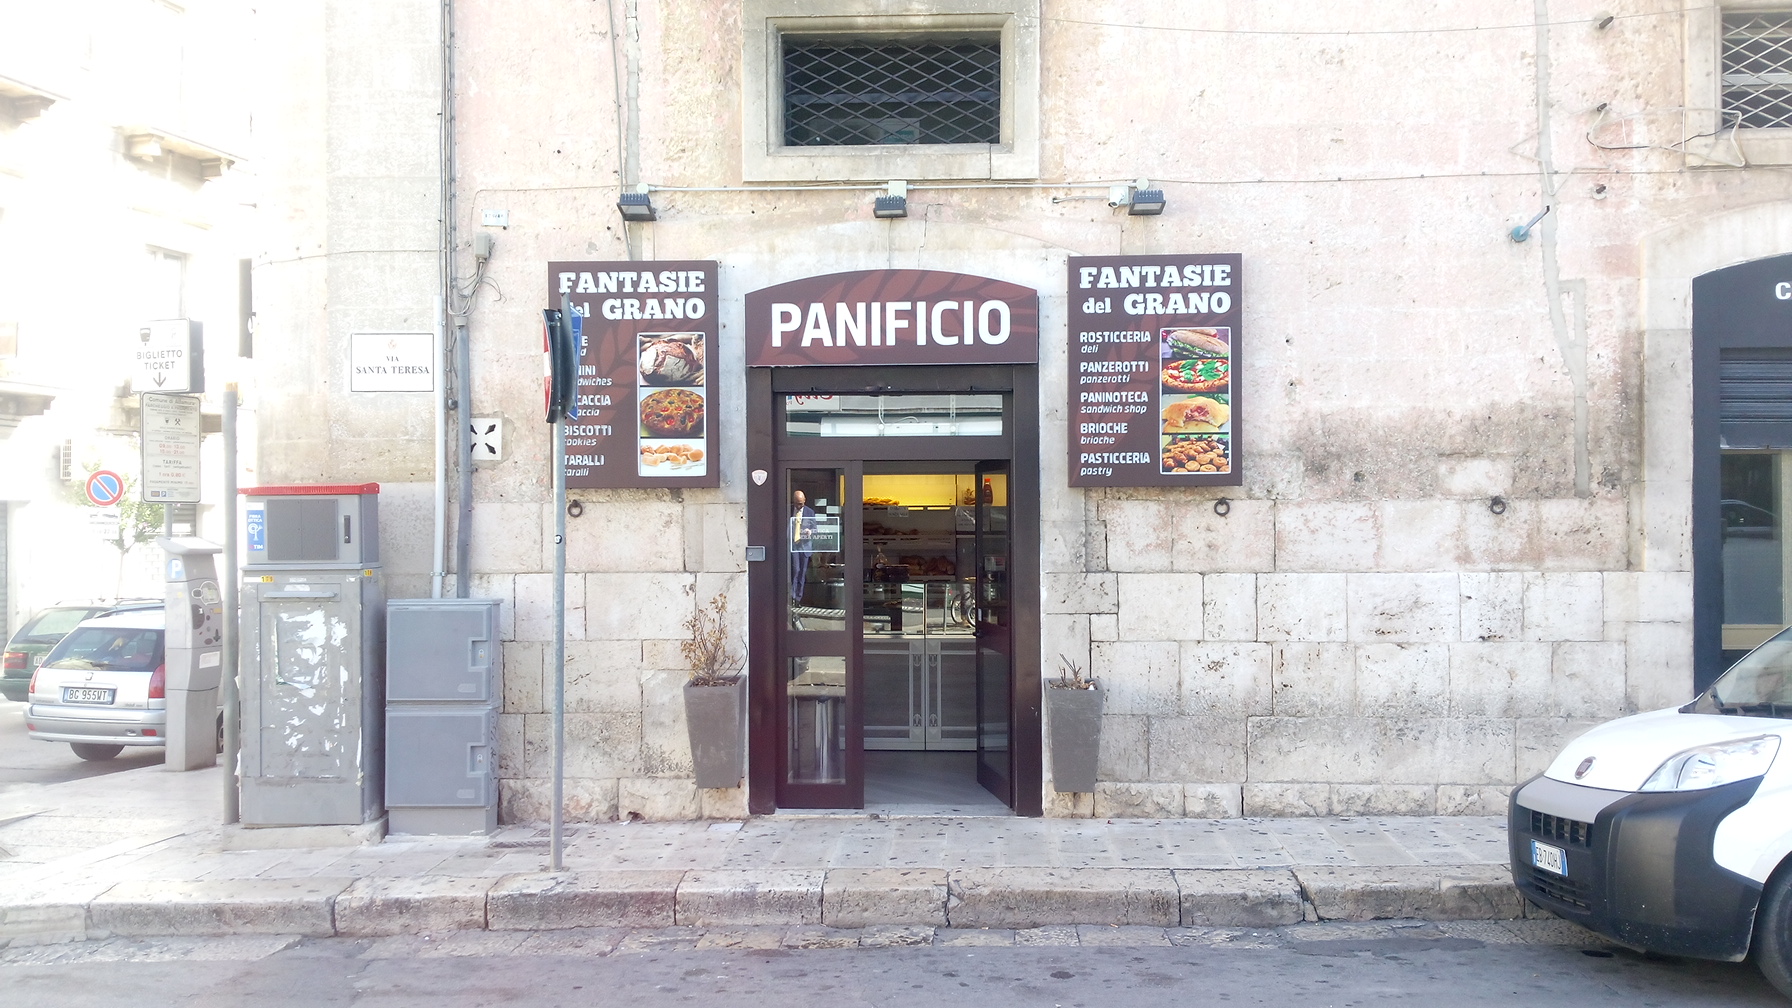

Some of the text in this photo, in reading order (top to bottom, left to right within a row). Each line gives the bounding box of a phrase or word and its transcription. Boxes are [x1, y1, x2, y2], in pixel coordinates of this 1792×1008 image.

[558, 271, 705, 293] FANTASIE
[1079, 264, 1231, 289] FANTASIE
[570, 298, 706, 320] el GRANO
[1083, 291, 1231, 315] del GRANO
[771, 299, 1011, 348] PANIFICIO
[1080, 331, 1151, 343] ROSTICCERIA
[136, 349, 183, 360] BIGLIETTO
[1081, 344, 1099, 354] deli
[144, 360, 175, 370] TICKET
[355, 365, 430, 375] SANTA TERESA
[1080, 361, 1149, 373] PANZEROTTI
[1080, 374, 1131, 385] panzerotti
[1080, 391, 1149, 403] PANINOTECA
[1080, 404, 1147, 415] sandwich shop
[1080, 423, 1128, 434] BRIOCHE
[565, 437, 597, 446] ookies
[1080, 435, 1116, 445] brioche
[1080, 452, 1151, 464] PASTICCERIA
[565, 467, 590, 476] aralli
[1080, 465, 1113, 477] pastry
[68, 689, 108, 701] BG 955WT
